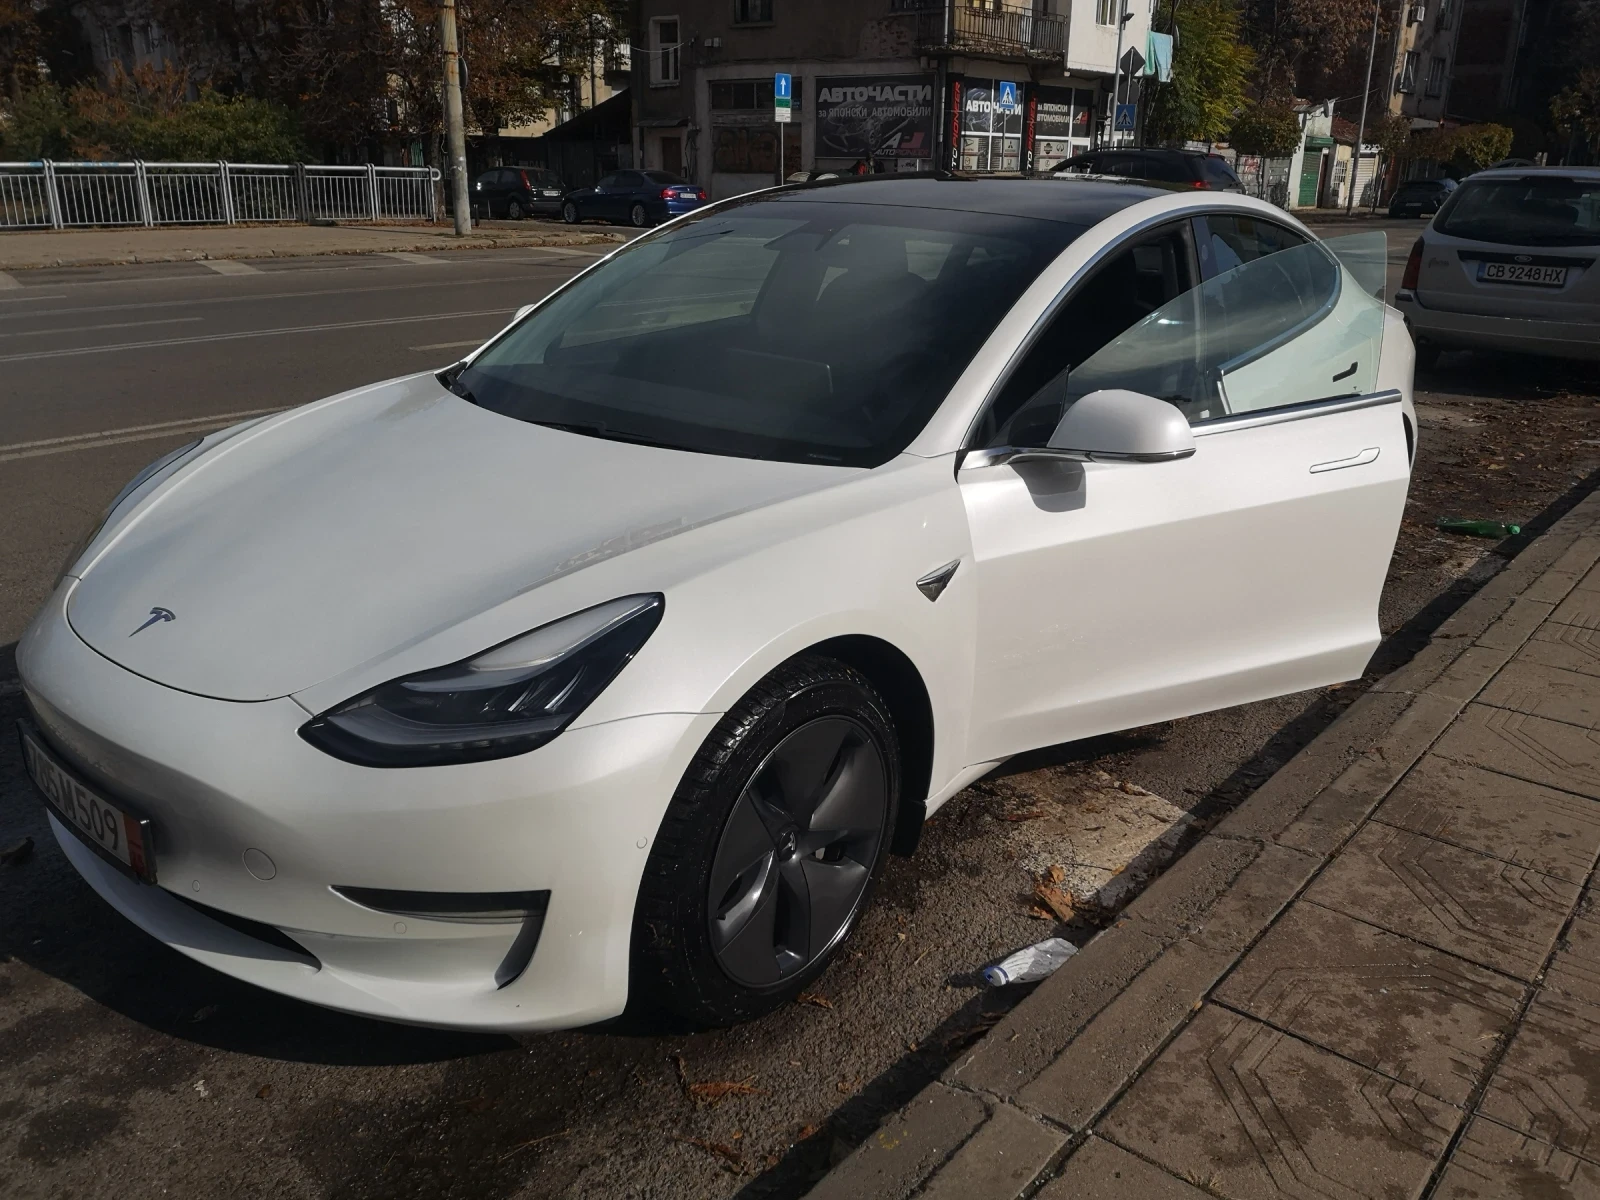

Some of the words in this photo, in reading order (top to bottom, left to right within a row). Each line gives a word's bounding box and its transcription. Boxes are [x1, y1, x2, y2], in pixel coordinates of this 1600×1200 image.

[818, 85, 932, 103] АВТОЧАСТИ
[828, 107, 868, 118] ЯПОНСКИ
[871, 106, 931, 117] АВТОМОБИЛИ
[1037, 113, 1070, 123] ВТОМОБИЛИ
[1487, 265, 1505, 278] CB
[1508, 266, 1541, 281] 9248
[1543, 268, 1563, 282] HX
